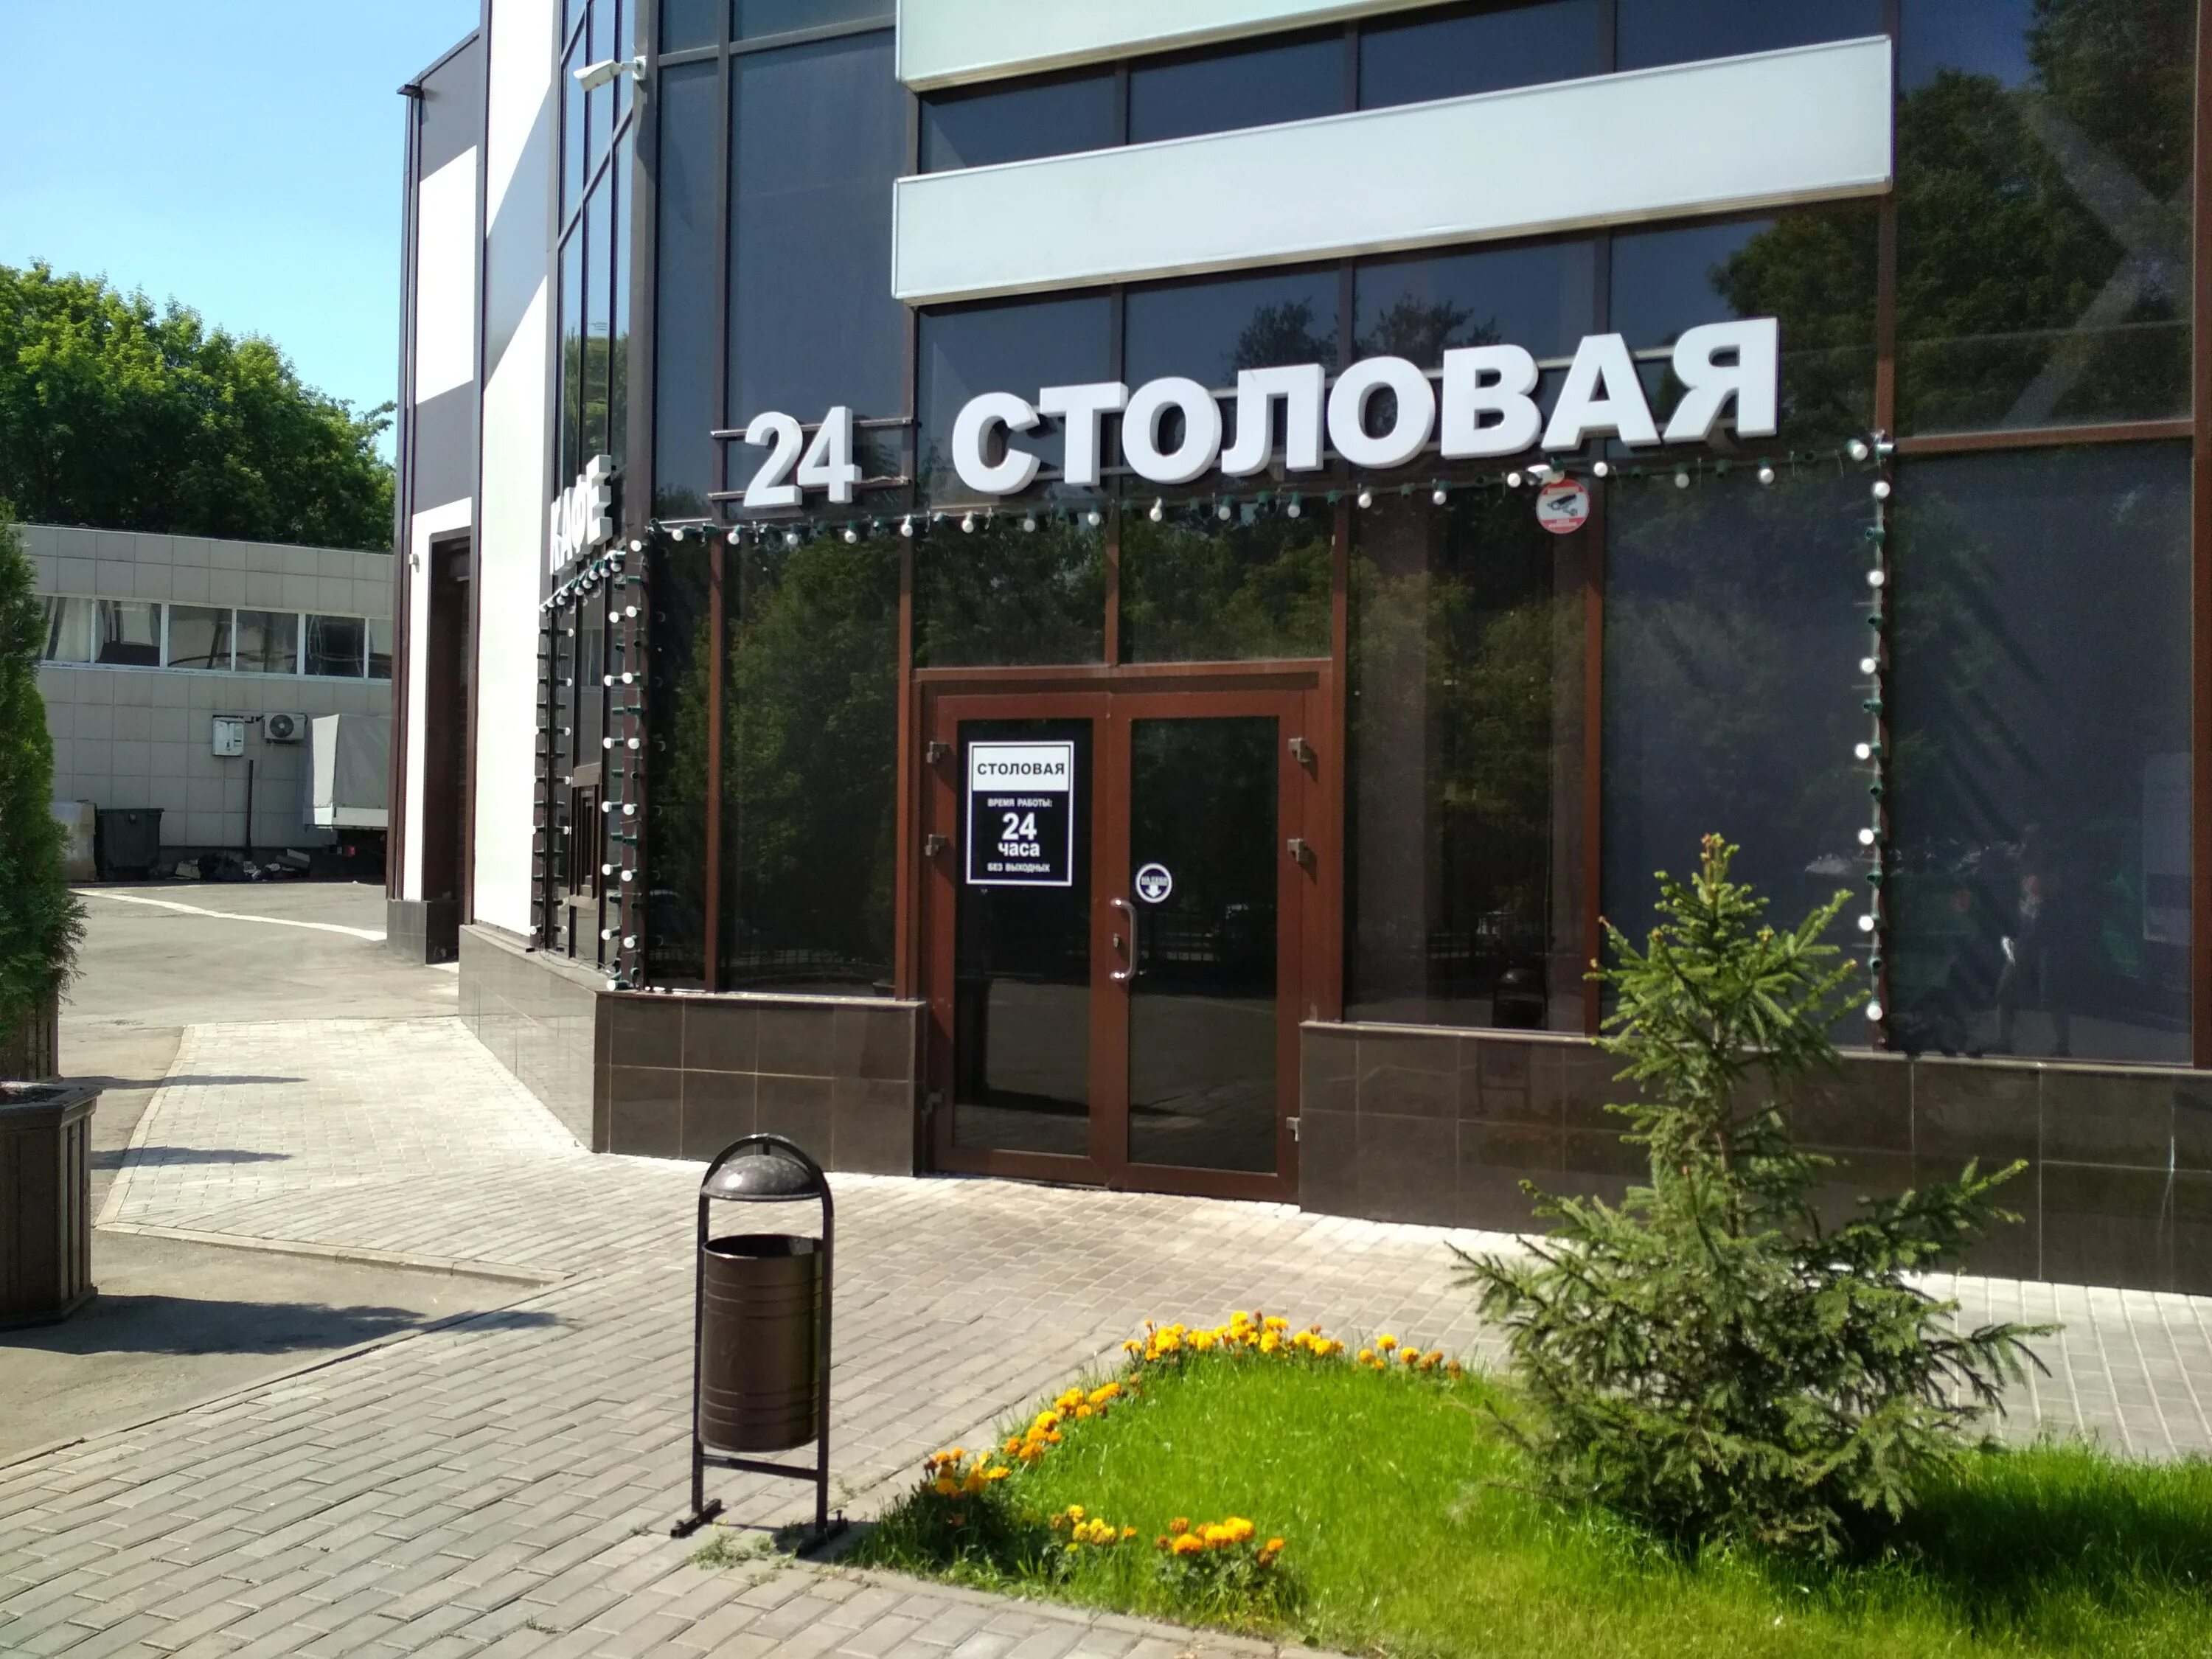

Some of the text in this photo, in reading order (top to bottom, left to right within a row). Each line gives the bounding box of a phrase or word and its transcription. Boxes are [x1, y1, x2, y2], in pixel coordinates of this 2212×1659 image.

[743, 318, 1778, 507] 24 СТОЛОВАЯ
[549, 454, 613, 576] КАФЕ
[977, 762, 1065, 775] СТОЛОВАЯ
[987, 798, 1015, 807] ВРЕМЯ
[1001, 812, 1037, 841] 24
[998, 842, 1040, 857] часа
